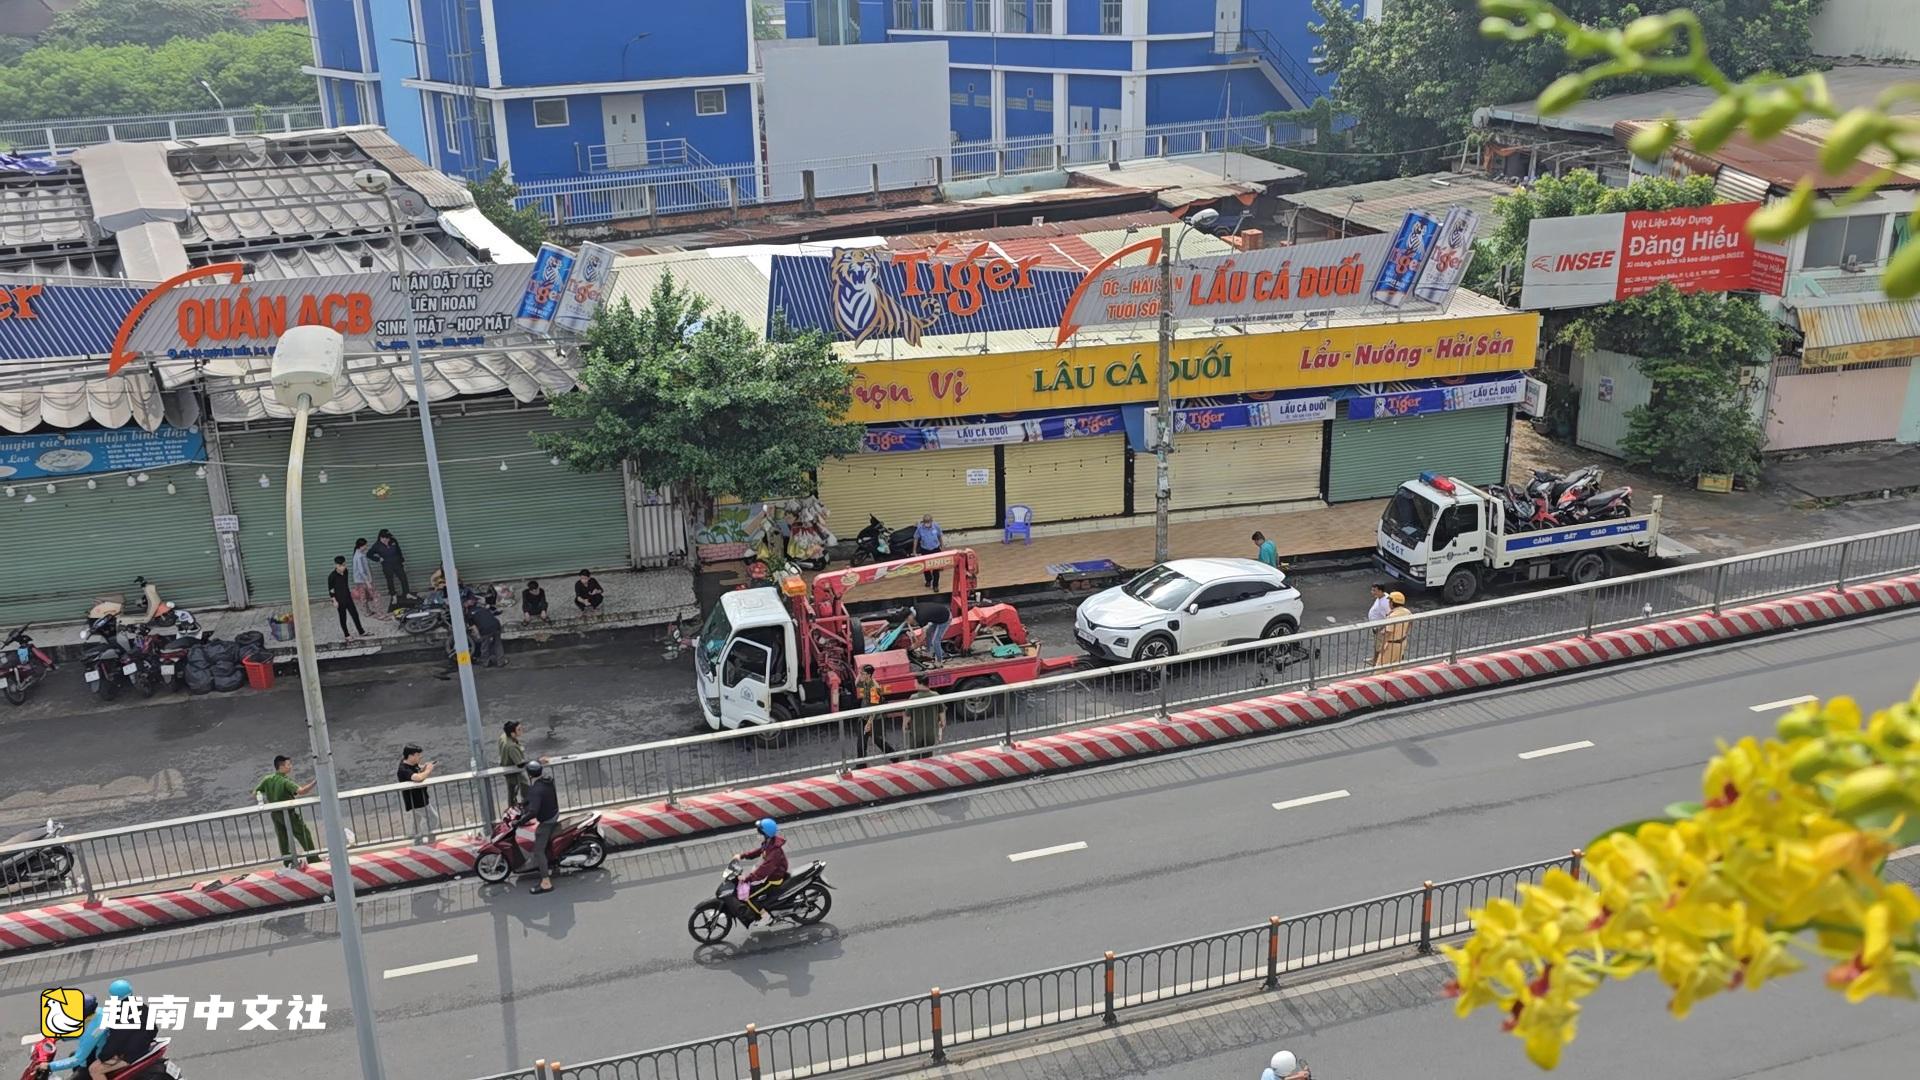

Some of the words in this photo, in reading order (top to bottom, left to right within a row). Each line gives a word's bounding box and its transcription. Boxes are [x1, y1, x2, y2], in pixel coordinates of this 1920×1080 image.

[1631, 219, 1647, 230] Vật
[1648, 218, 1668, 228] Liệu
[1669, 216, 1686, 227] Xây
[1688, 215, 1713, 226] Dựng
[1629, 234, 1686, 258] Đăng
[1691, 225, 1739, 251] Hiếu
[1555, 250, 1616, 272] INSEE
[432, 271, 459, 293] ĐẶT
[464, 269, 493, 292] TIỆC
[892, 240, 1041, 317] Tiger
[1253, 260, 1291, 302] CÁ
[1297, 253, 1364, 299] ĐUỐI
[441, 295, 477, 311] HOAN
[178, 287, 287, 347] QUÁN
[297, 292, 371, 335] ACB
[376, 319, 407, 336] SINH
[457, 317, 483, 335] HỌP
[485, 313, 512, 334] MẶT
[1300, 339, 1340, 370] Lẩu
[1354, 340, 1422, 368] Nướng
[1436, 331, 1473, 359] Hải
[1476, 331, 1514, 356] Sản
[1104, 352, 1148, 387] CÁ
[929, 369, 968, 404] Vị
[1387, 396, 1422, 413] Tiger
[1077, 415, 1114, 433] Tiger
[1188, 410, 1225, 429] Tiger
[867, 431, 905, 450] Tiger
